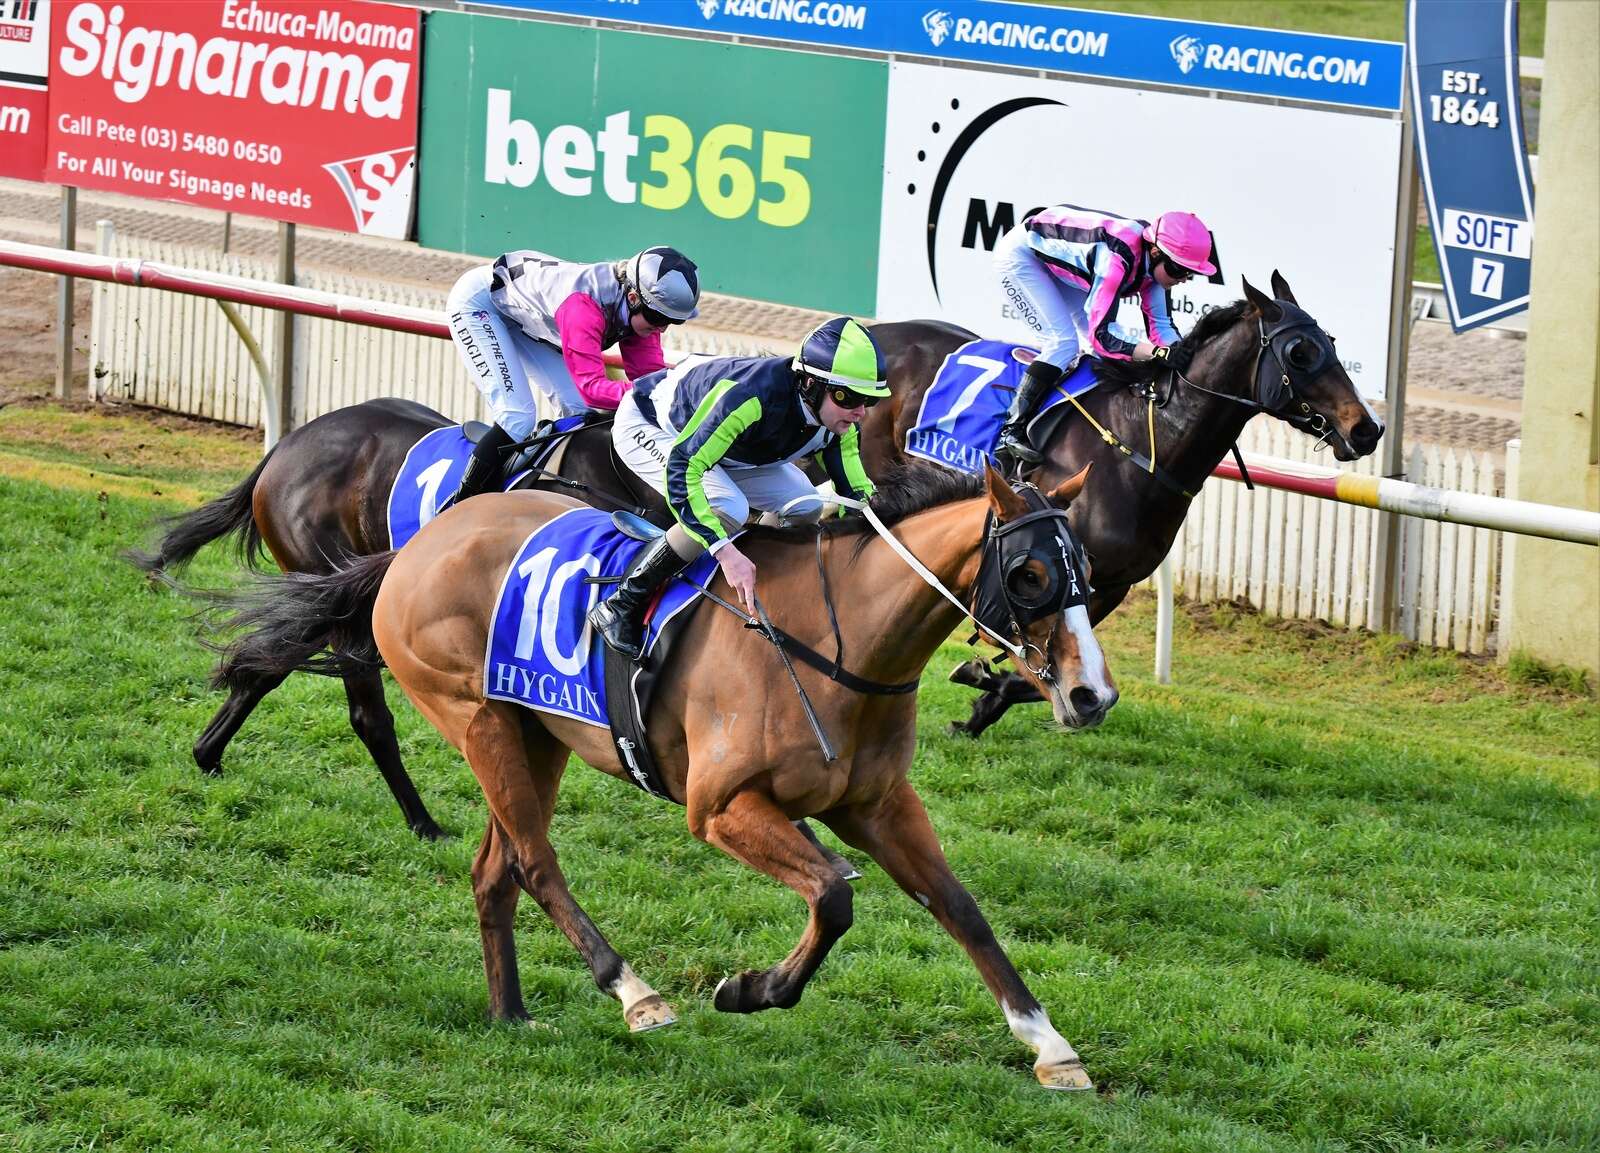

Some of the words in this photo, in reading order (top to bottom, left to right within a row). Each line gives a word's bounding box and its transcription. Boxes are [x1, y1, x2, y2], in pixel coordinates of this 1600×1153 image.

[221, 0, 413, 51] Echuca-Moama
[724, 0, 867, 30] RACING.COM
[954, 21, 1109, 57] RACING.COM
[59, 3, 411, 120] Signarama
[1204, 44, 1370, 86] RACING.COM
[1441, 70, 1487, 95] EST.
[1430, 95, 1500, 129] 1864
[58, 113, 92, 137] Call
[96, 118, 136, 143] Pete
[141, 125, 177, 152] (03)
[182, 132, 229, 157] 5480
[233, 140, 282, 165] 0650
[484, 87, 811, 227] bet365
[57, 151, 87, 173] For
[92, 157, 117, 178] All
[121, 161, 164, 185] Your
[169, 168, 246, 201] Signage
[250, 181, 312, 209] Needs
[1456, 214, 1519, 252] SOFT
[1481, 263, 1496, 292] 7
[1001, 276, 1043, 332] WORSNOP
[457, 327, 493, 378] EDGLEY
[482, 323, 498, 341] OFF
[490, 341, 504, 361] THE
[497, 361, 515, 393] TRACK
[935, 355, 1008, 434] 7
[415, 458, 454, 529] 1
[514, 546, 601, 677] 10
[496, 662, 602, 719] HYGAIN
